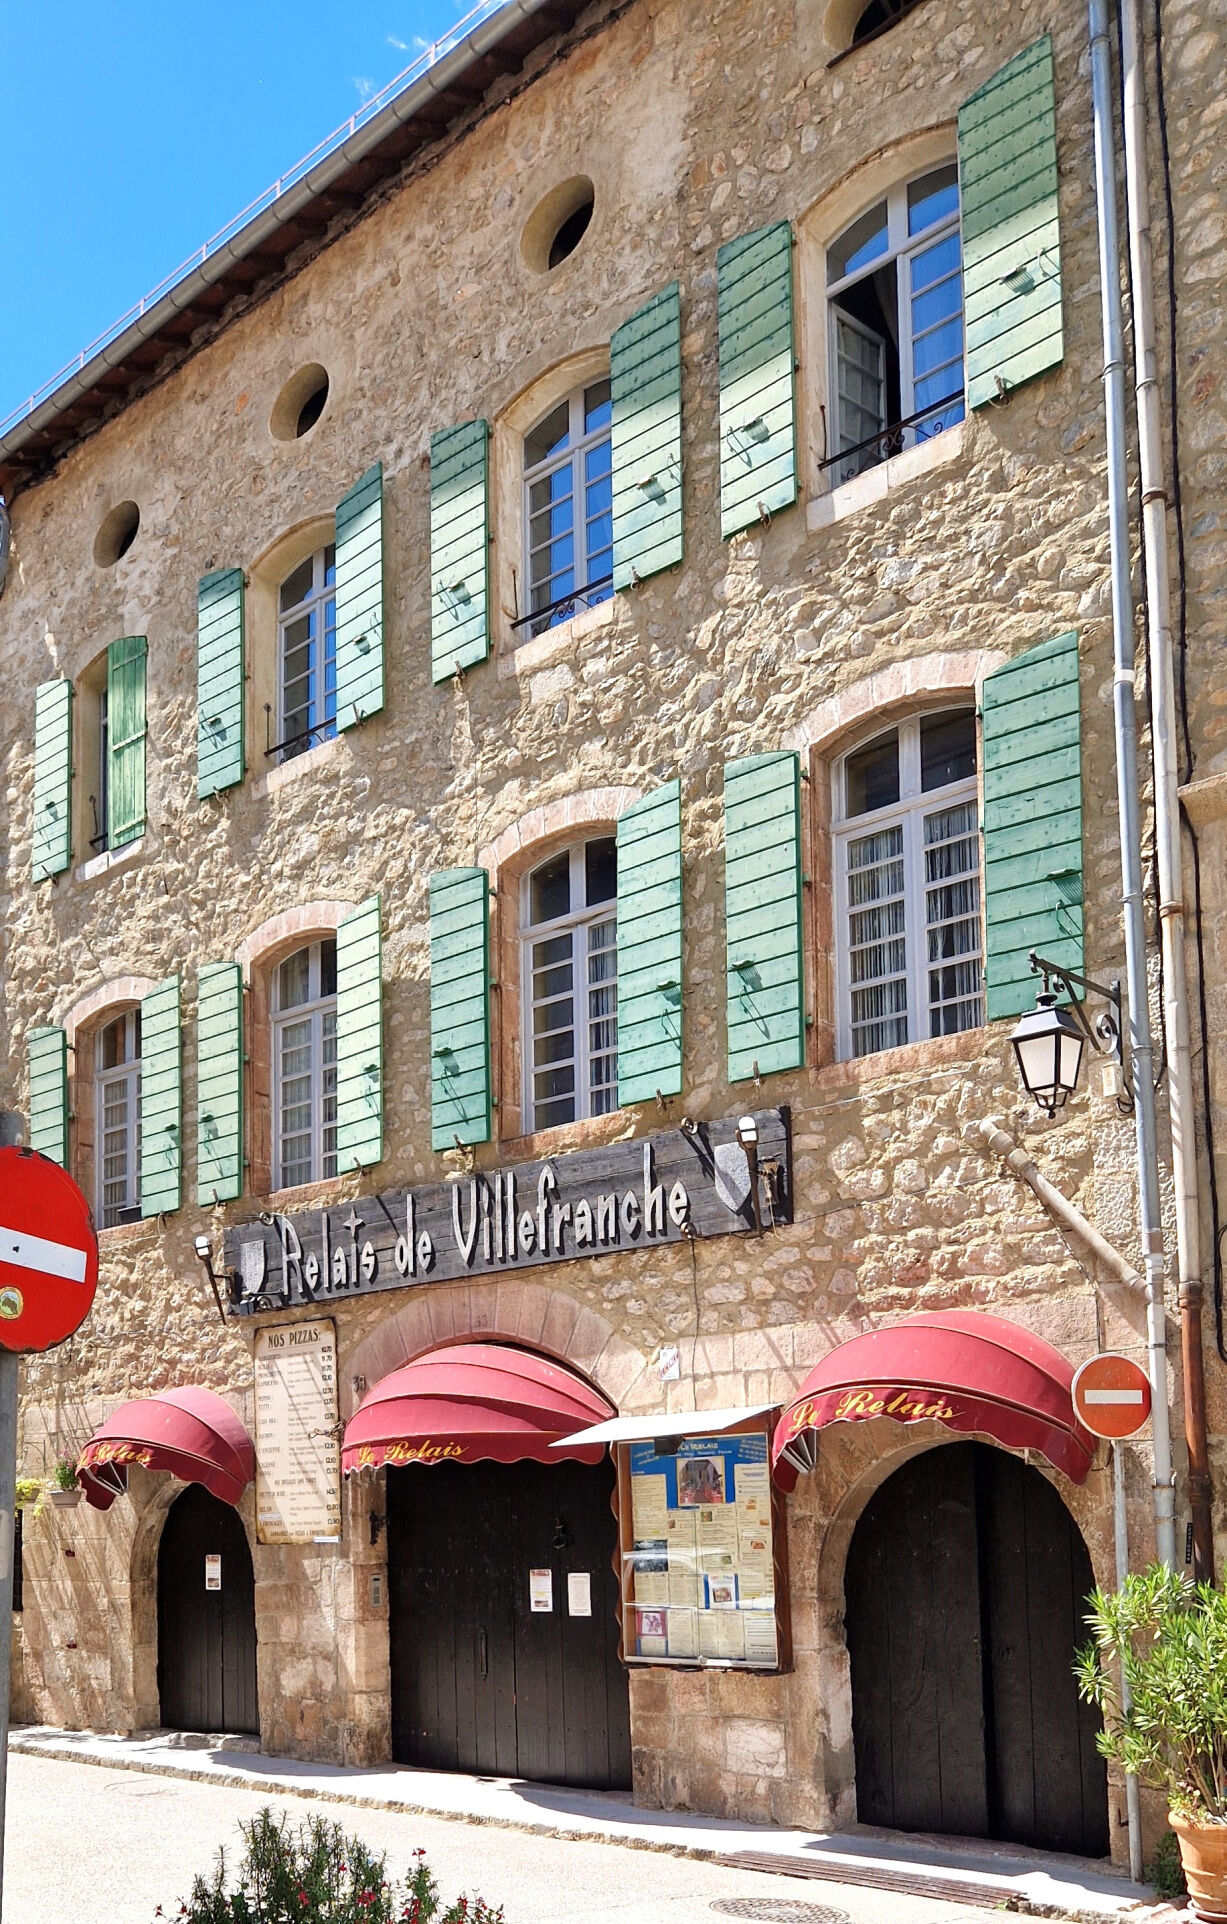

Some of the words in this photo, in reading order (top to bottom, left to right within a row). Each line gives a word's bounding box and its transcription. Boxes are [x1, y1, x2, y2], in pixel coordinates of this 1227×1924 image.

[282, 1205, 377, 1296] Relais
[395, 1193, 434, 1274] de
[452, 1142, 692, 1268] Villefranche
[268, 1333, 285, 1349] NOS
[835, 1391, 967, 1418] Relais
[358, 1445, 375, 1464] Le
[384, 1439, 469, 1461] Relais
